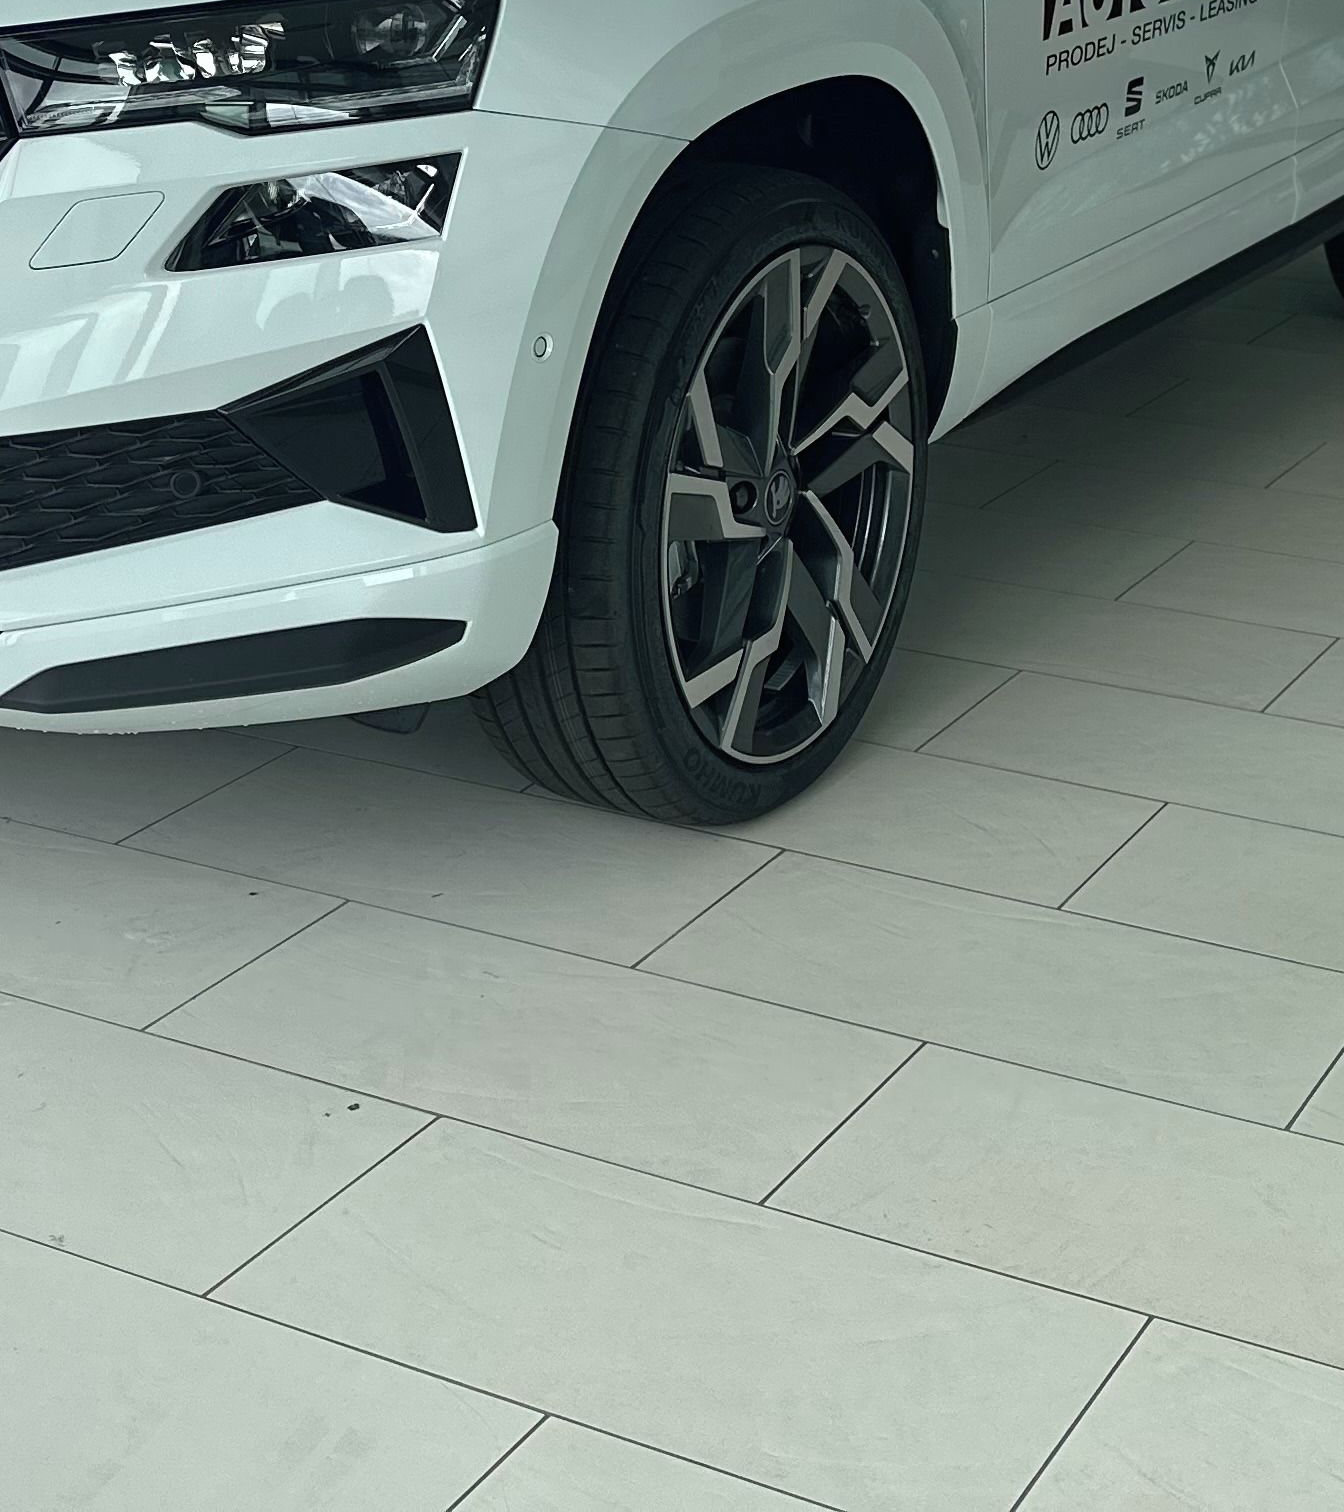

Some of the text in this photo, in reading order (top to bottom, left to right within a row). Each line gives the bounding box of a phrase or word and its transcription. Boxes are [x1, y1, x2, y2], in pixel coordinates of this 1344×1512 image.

[1045, 34, 1116, 76] PRODEJ
[1131, 10, 1186, 45] SERVIS
[1193, 87, 1222, 105] CUPRA
[1116, 119, 1146, 140] SEAT
